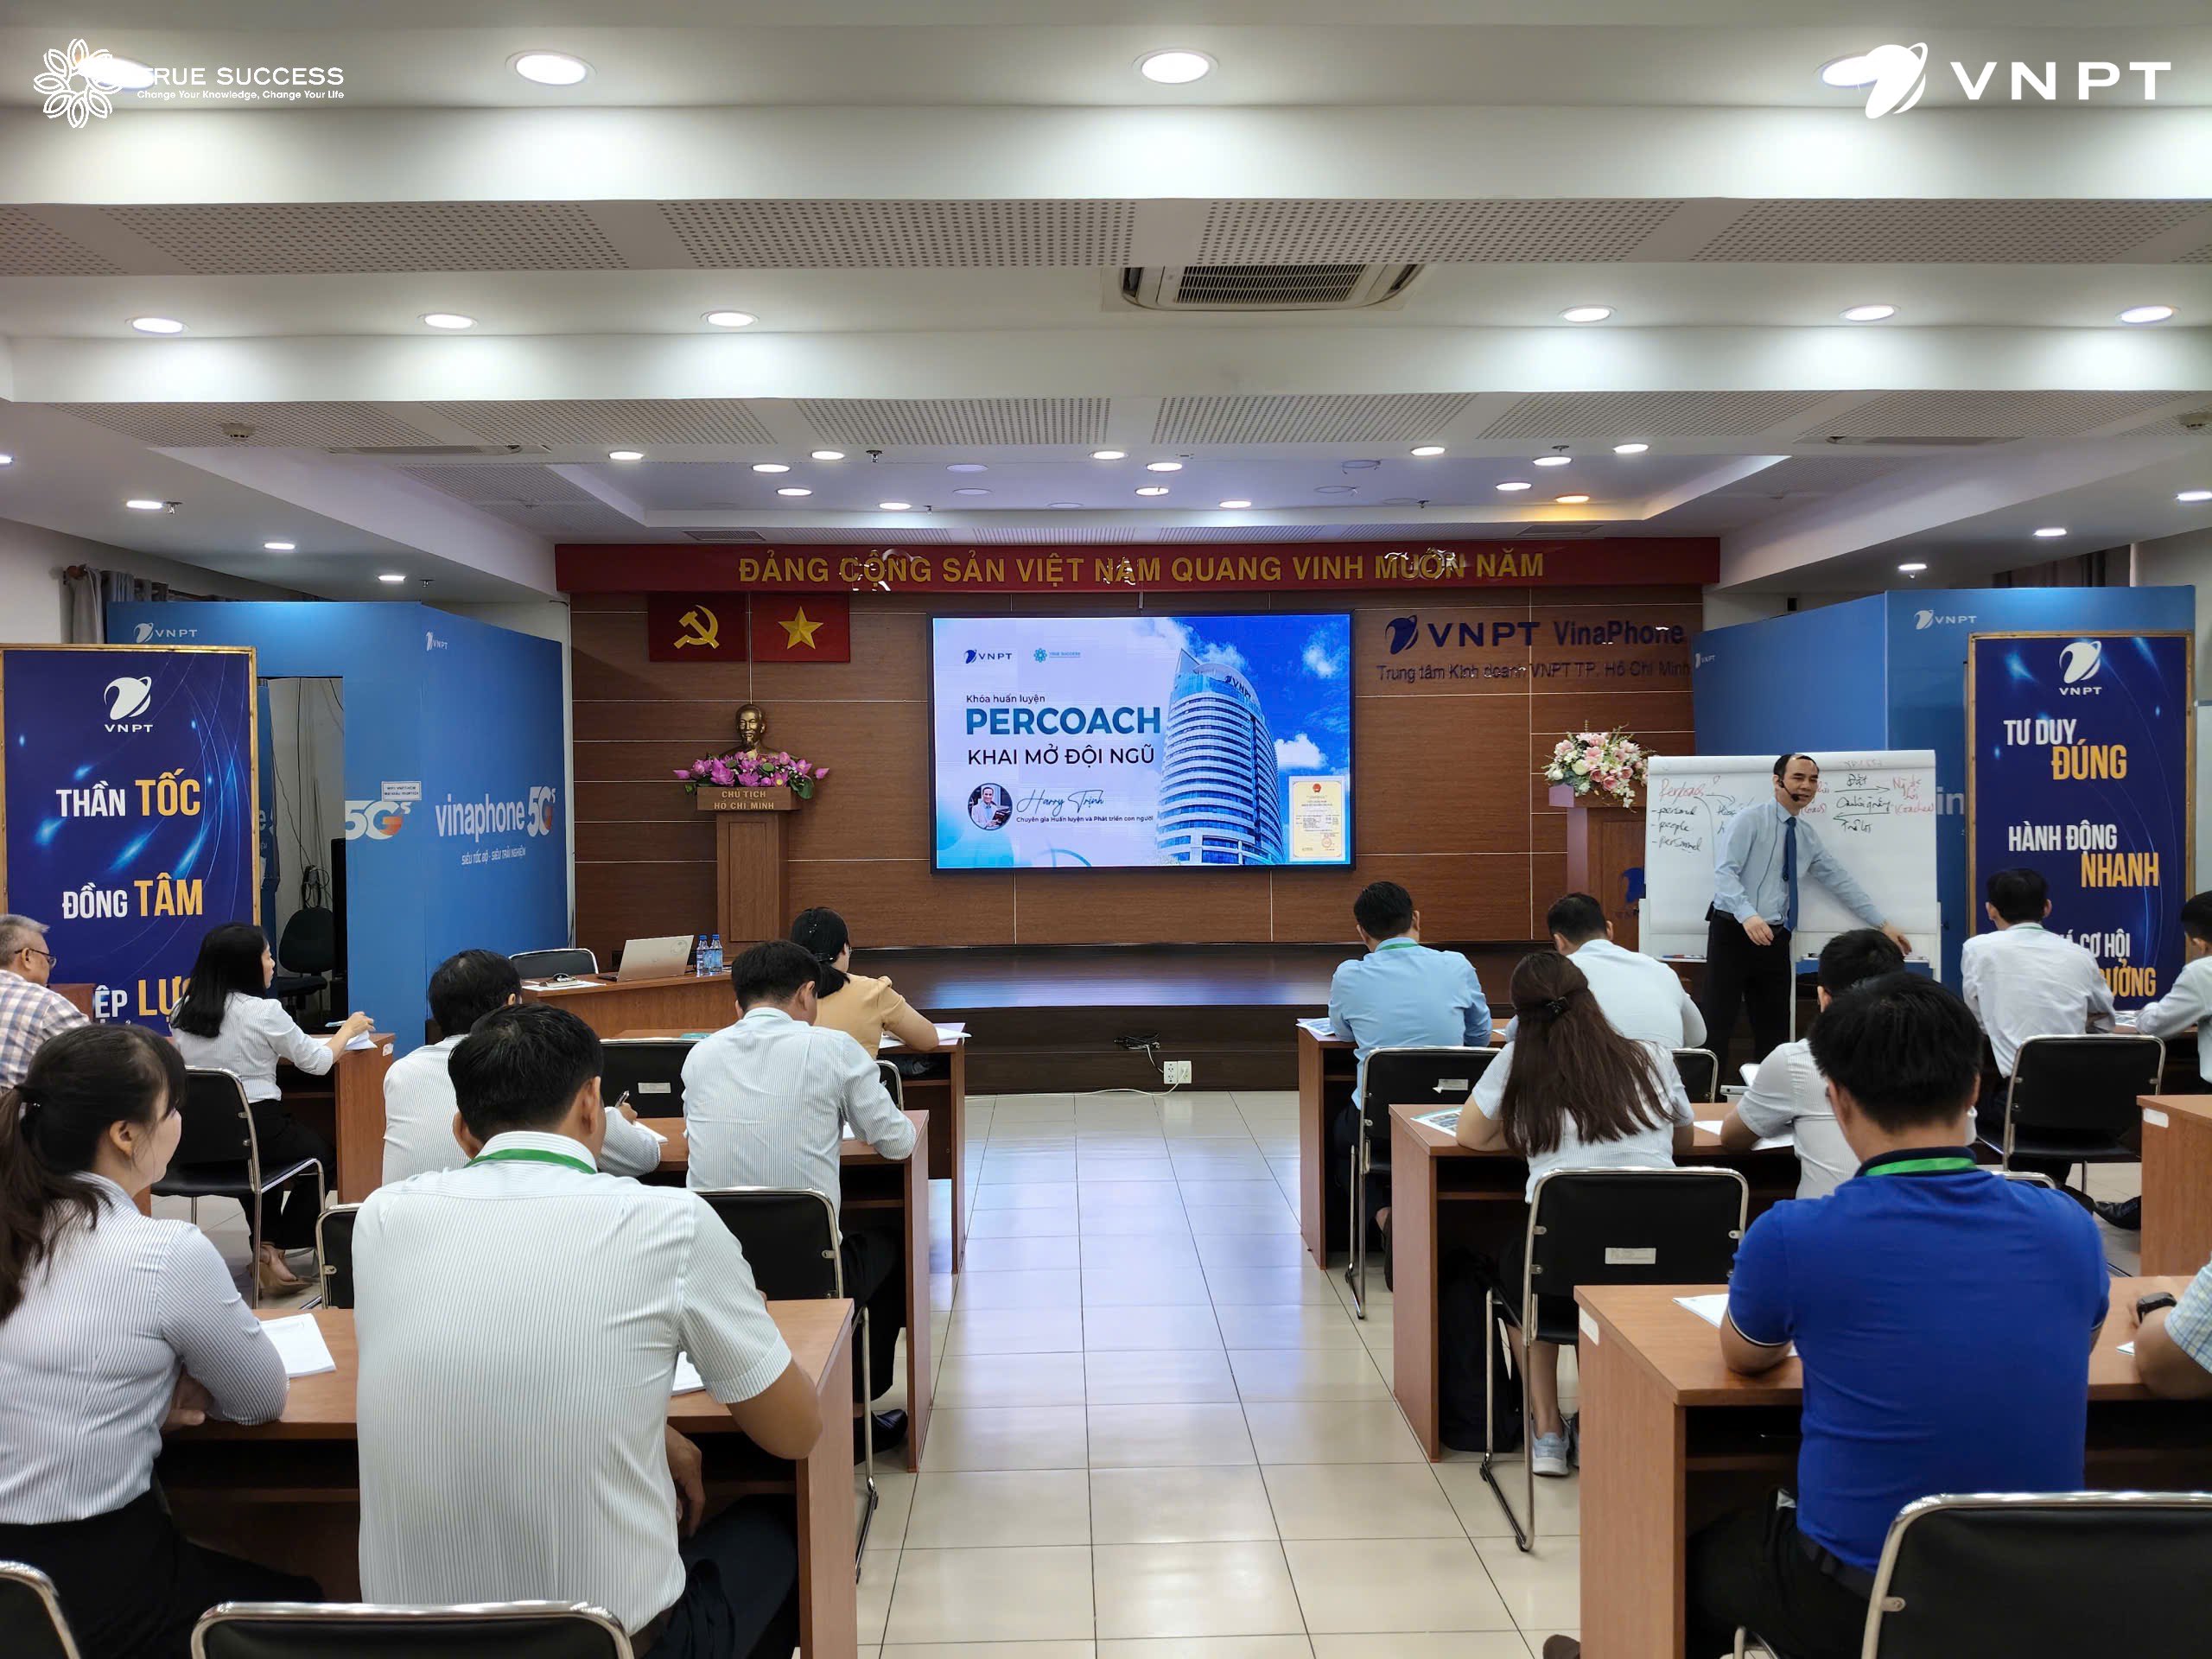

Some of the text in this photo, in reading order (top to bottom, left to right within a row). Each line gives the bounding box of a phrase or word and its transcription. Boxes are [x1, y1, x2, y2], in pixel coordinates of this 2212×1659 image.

[739, 548, 1544, 588] ĐẢNG CỘNG SẢN VIỆT NAM QUANG VINH MUÔN NĂM
[155, 629, 198, 638] VNPT
[1427, 620, 1685, 647] VNPT VinaPhone
[1935, 615, 1978, 624] VNPT
[1376, 664, 1415, 683] Trung
[1419, 664, 1445, 679] tâm
[1449, 664, 1479, 679] Kinh
[1484, 663, 1528, 678] doanh
[1530, 662, 1571, 677] VNPT
[966, 694, 1046, 704] Khóa huấn luyện
[2059, 686, 2102, 696] VNPT
[104, 724, 154, 733] VNPT
[966, 707, 1160, 735] PERCOACH
[2003, 718, 2077, 746] TƯ DUY
[968, 743, 1154, 768] KHAI MỞ ĐỘI NGŨ
[2050, 738, 2127, 780] ĐÚNG
[56, 768, 200, 817] THẦN TỐC
[743, 791, 766, 799] TỊCH
[435, 792, 525, 843] vinaphone
[2008, 819, 2118, 855] HÀNH ĐỘNG
[2081, 852, 2159, 888] NHANH
[62, 873, 203, 919] ĐỒNG TÂM
[2104, 928, 2131, 962] HỘI
